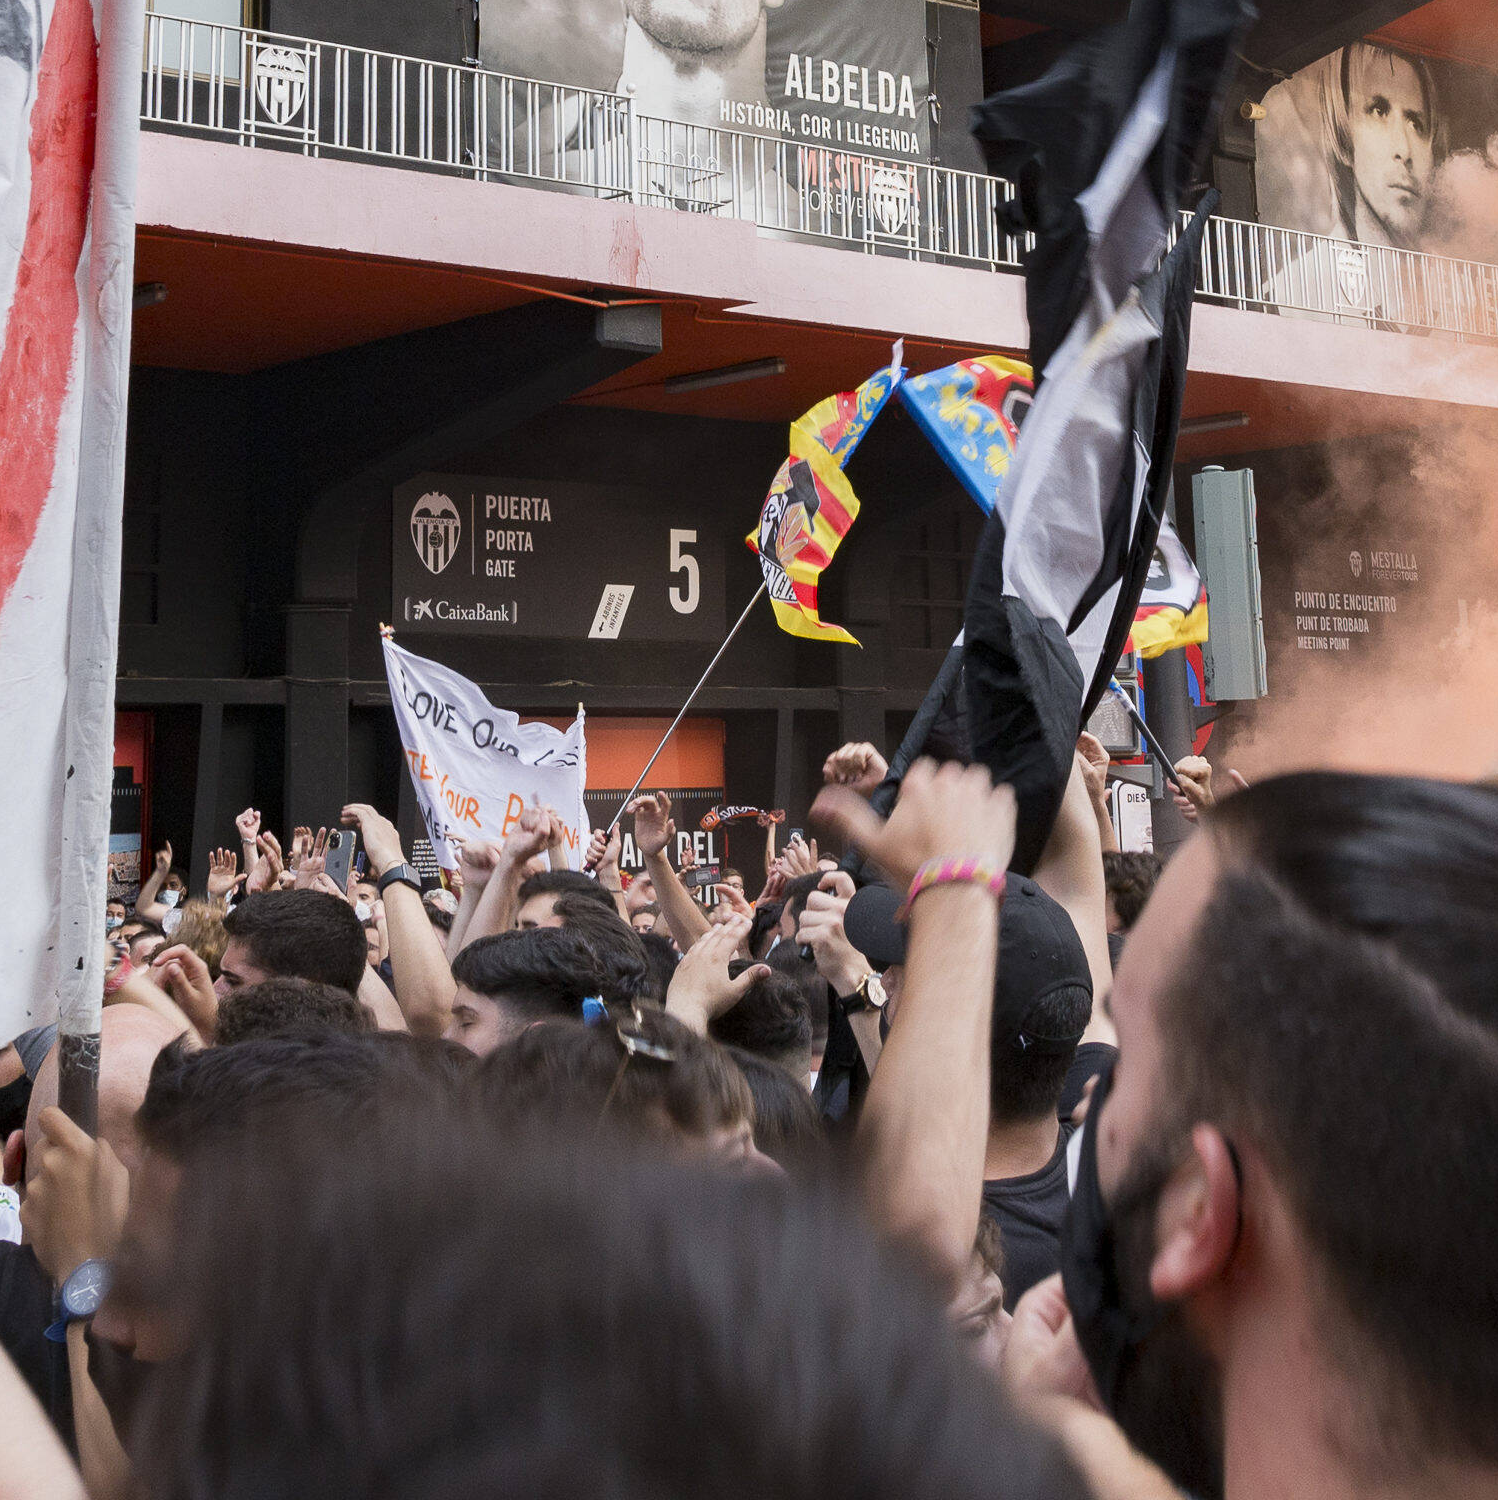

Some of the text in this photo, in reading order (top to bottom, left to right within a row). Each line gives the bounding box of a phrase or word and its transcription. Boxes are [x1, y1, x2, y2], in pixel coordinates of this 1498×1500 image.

[784, 53, 916, 119] ALBELDA
[719, 99, 920, 155] HISTÒRIA, COR I LLEGENDA
[485, 494, 552, 522] PUERTA
[414, 517, 445, 525] VALENCIA
[485, 529, 534, 552] PORTA
[485, 560, 516, 578] GATE
[667, 528, 701, 615] 5
[1371, 551, 1418, 571] MESTALLA
[435, 600, 510, 622] CaixaBank
[1294, 591, 1397, 613] PUNTO DE ENCUENTRO
[1296, 615, 1369, 633] PUNT DE TROBADA
[1297, 636, 1350, 651] MEETING POINT
